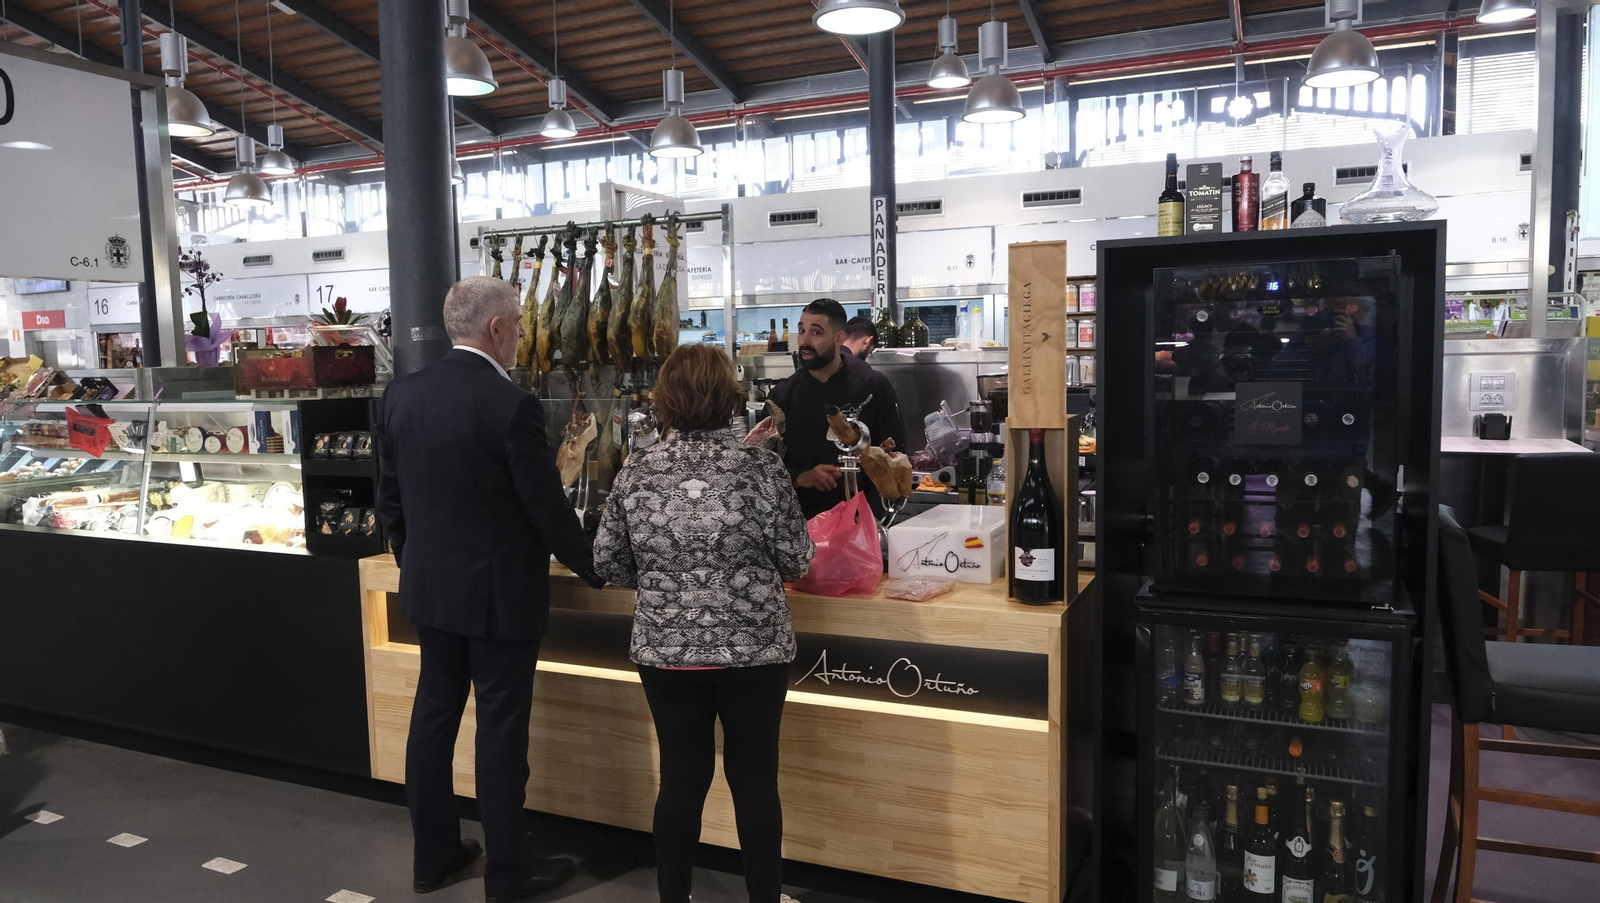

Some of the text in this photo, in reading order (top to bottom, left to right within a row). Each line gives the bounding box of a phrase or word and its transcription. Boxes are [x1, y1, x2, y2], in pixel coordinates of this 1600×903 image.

[1189, 189, 1221, 197] TOMATIN
[70, 256, 99, 268] C-6.1
[851, 257, 871, 265] CAFET
[687, 265, 711, 273] AFETERÍA
[1267, 281, 1279, 291] 16
[316, 285, 334, 304] 17
[94, 298, 109, 315] 16
[944, 550, 982, 573] Ortuño
[795, 649, 979, 698] Antonio Ortuño
